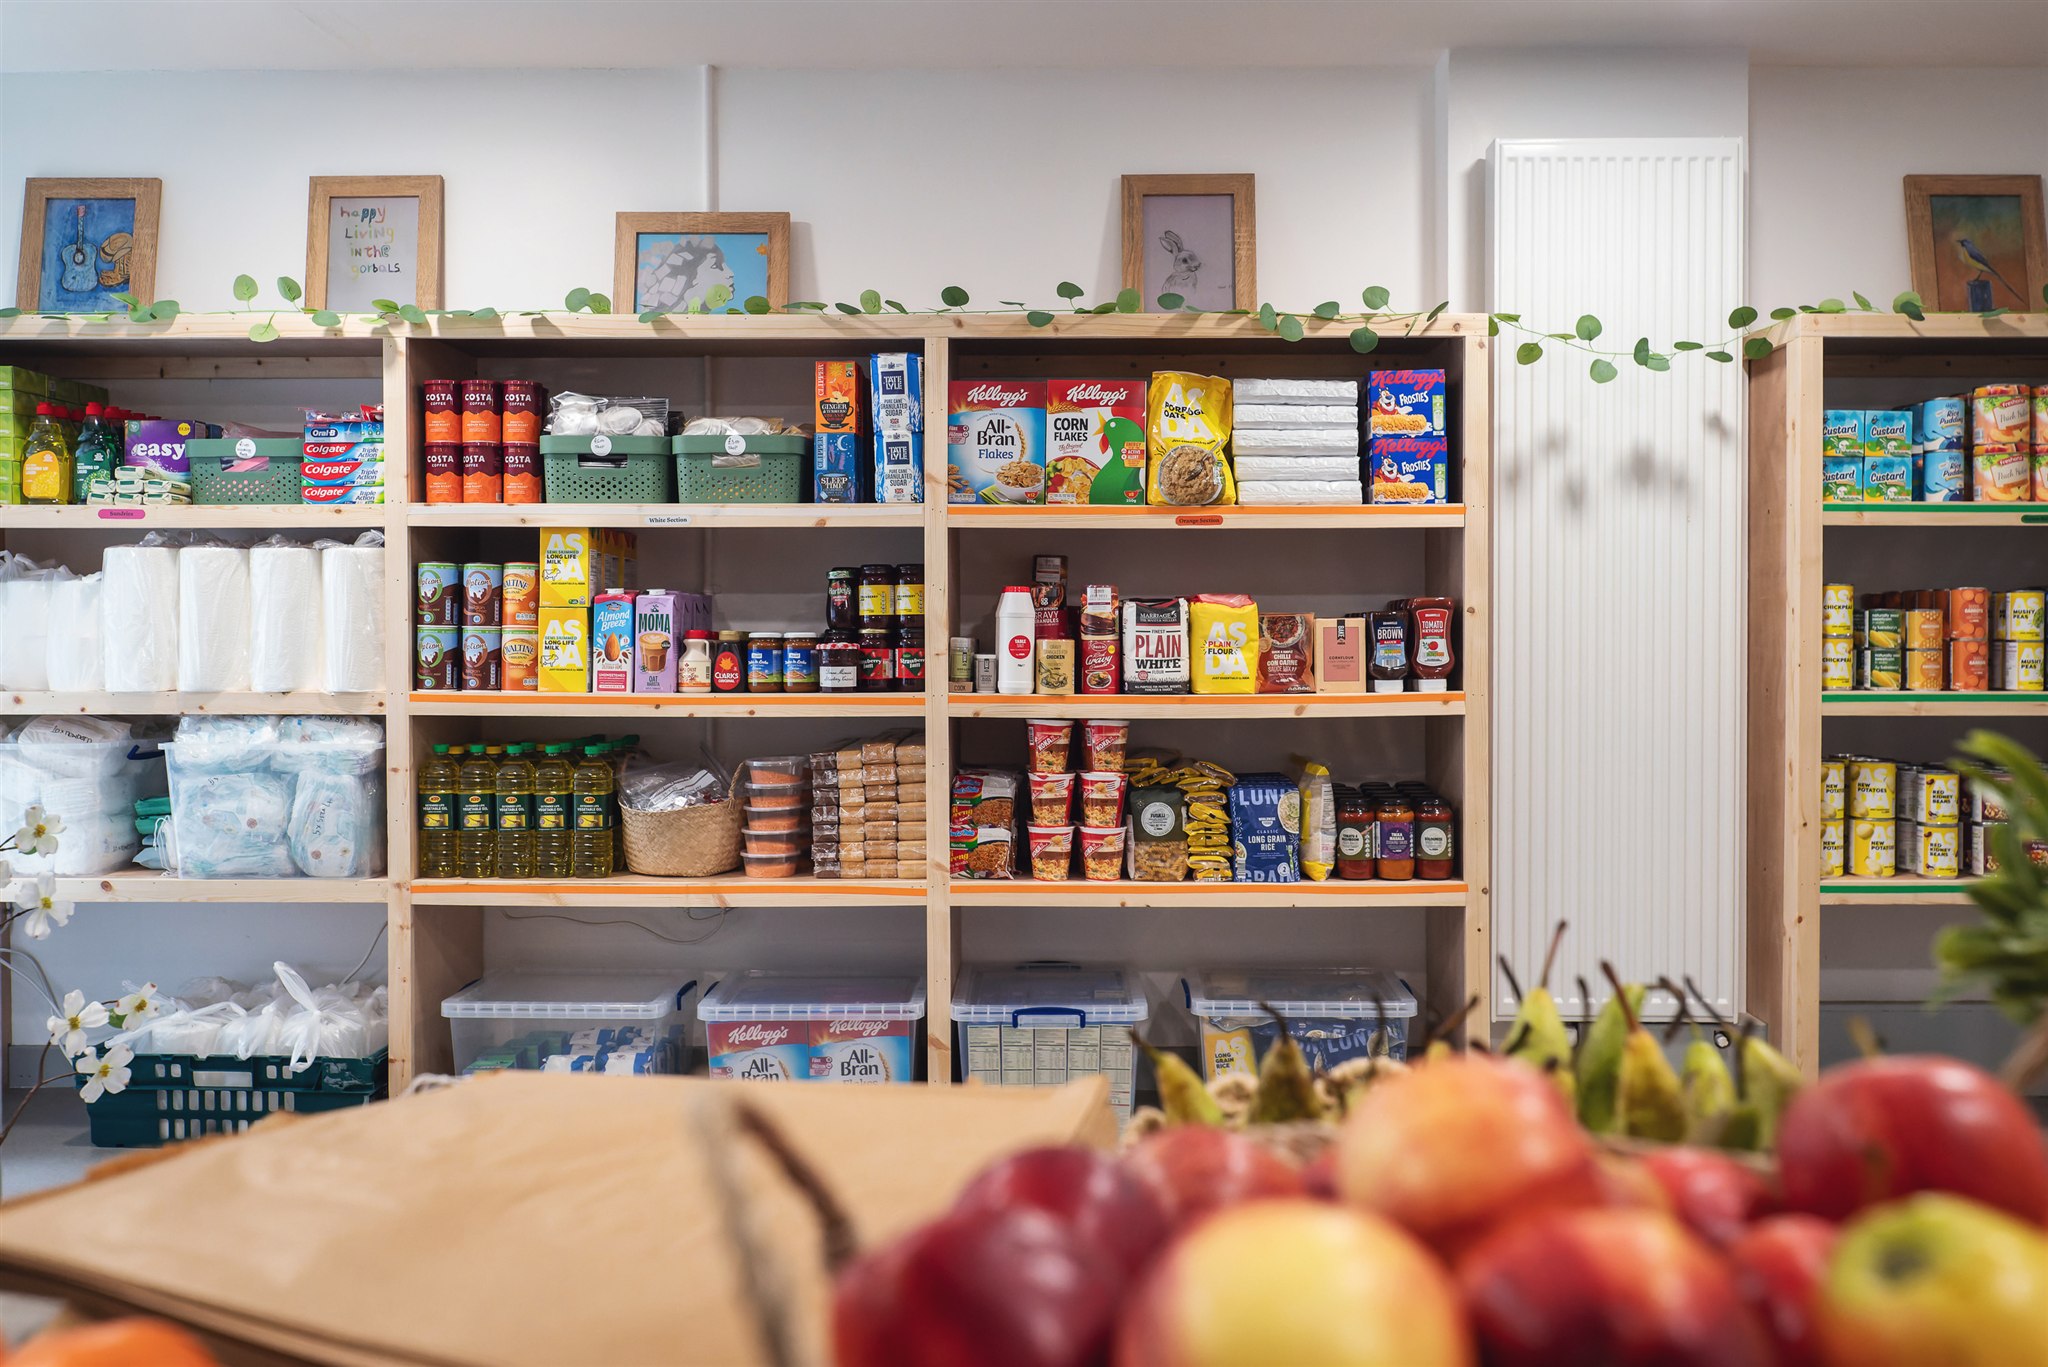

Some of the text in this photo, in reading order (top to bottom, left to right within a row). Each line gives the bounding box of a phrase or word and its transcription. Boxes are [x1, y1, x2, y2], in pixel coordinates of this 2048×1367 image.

[340, 206, 386, 224] happy
[1371, 369, 1446, 391] Kellogg's
[426, 393, 453, 401] COSTA
[464, 393, 492, 401] COSTA
[504, 393, 532, 402] COSTA
[967, 384, 1029, 407] Kellogg's
[1066, 383, 1129, 407] Kellogg's
[1399, 390, 1429, 406] FROSTIES
[1054, 418, 1088, 431] CORN
[1871, 424, 1905, 437] Custard
[977, 431, 1015, 446] Bran
[1054, 432, 1088, 441] FLAKES
[136, 443, 187, 460] easy
[306, 444, 347, 455] Colgate
[978, 449, 1014, 459] Flakes
[1374, 437, 1447, 459] Kellogg's
[427, 455, 454, 463] COSTA
[504, 455, 531, 463] COSTA
[305, 464, 351, 478] Colgate
[1401, 458, 1432, 474] FROSTIES
[1870, 470, 1905, 482] Custard
[304, 487, 344, 498] Colgate
[597, 609, 631, 622] Almond
[600, 620, 627, 632] Breeze
[638, 613, 671, 634] MOMA
[1421, 620, 1443, 629] TOMATO
[1377, 629, 1403, 639] BROWN
[1135, 635, 1181, 658] PLAIN
[1135, 658, 1181, 669] WHITE
[1260, 843, 1276, 851] RICE
[728, 1024, 789, 1045] Kellogg's
[840, 1061, 879, 1077] Bran
